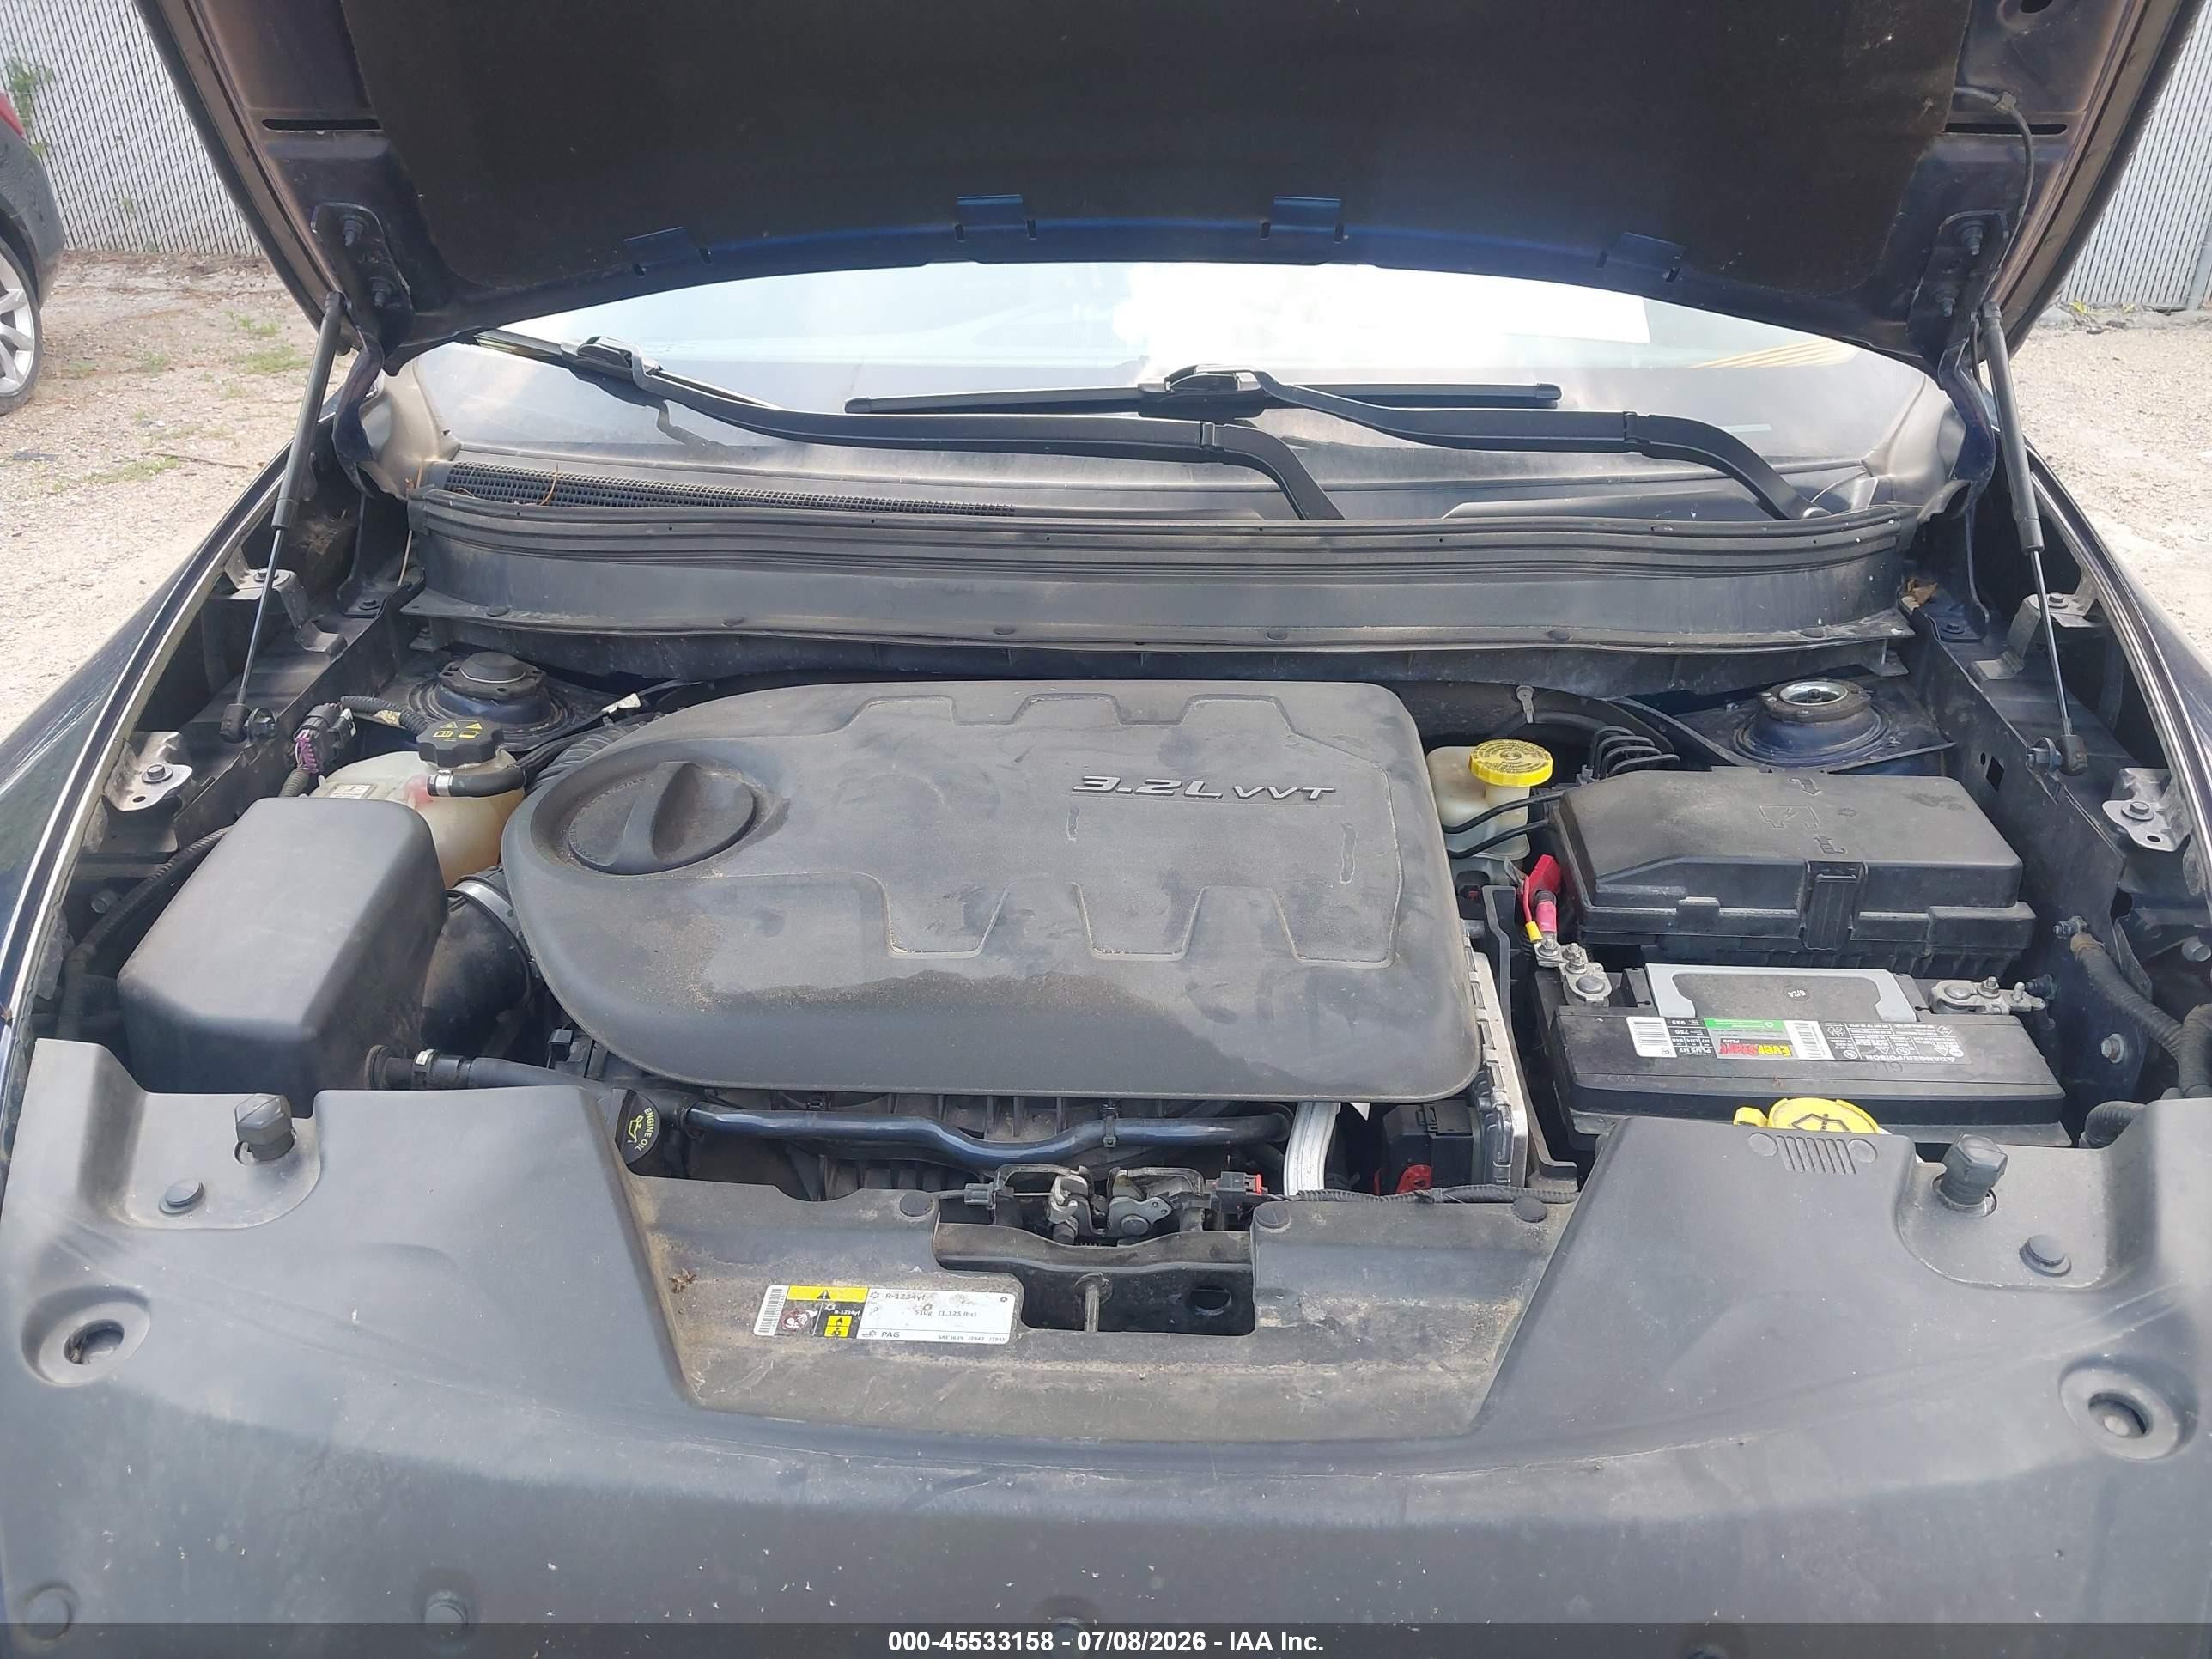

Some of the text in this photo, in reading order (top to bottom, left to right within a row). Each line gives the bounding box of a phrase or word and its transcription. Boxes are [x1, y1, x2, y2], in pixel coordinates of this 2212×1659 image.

[1073, 775, 1337, 800] 3.2L VVT
[1719, 1043, 1792, 1057] EverStart
[635, 1107, 654, 1152] ENGINE OIL
[885, 1292, 926, 1301] R-1234yf
